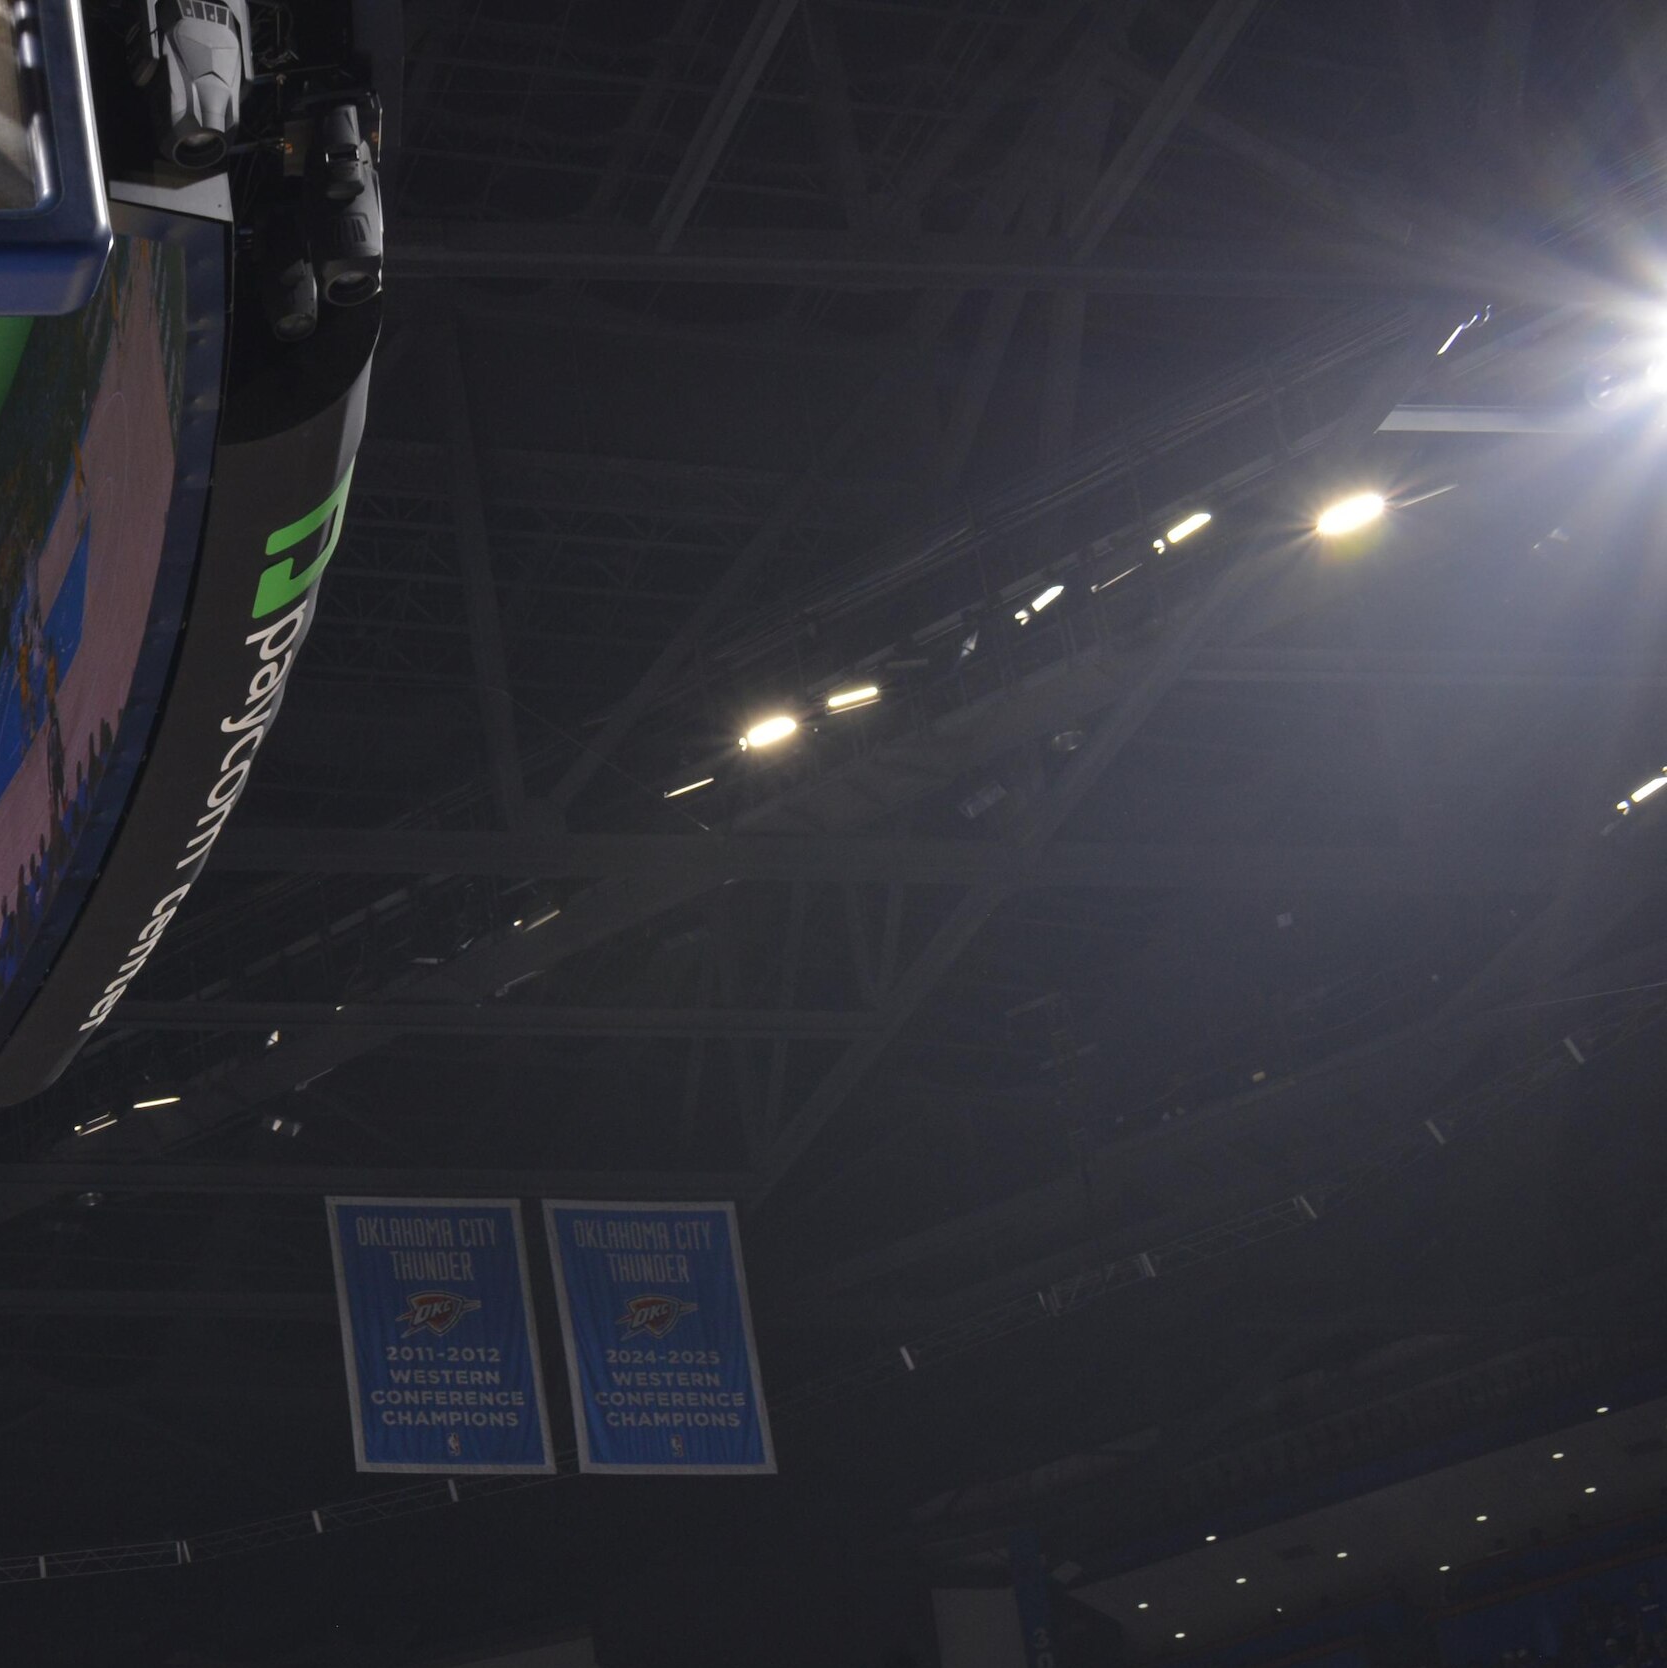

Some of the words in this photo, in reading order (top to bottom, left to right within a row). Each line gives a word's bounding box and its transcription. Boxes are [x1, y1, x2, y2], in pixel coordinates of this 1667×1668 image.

[175, 598, 310, 870] paycom
[78, 882, 191, 1032] center
[355, 1216, 454, 1248] OKLAHOMA
[459, 1216, 498, 1247] CITY
[572, 1219, 668, 1251] OKLAHOMA
[674, 1221, 712, 1252] CITY
[390, 1251, 475, 1281] THUNDER
[605, 1254, 690, 1284] THUNDER
[385, 1346, 501, 1364] 2011-2012
[605, 1349, 720, 1366] 2024-2025
[390, 1369, 501, 1386] WESTERN
[611, 1372, 721, 1388] WESTERN
[370, 1390, 525, 1407] CONFERENCE
[594, 1391, 746, 1409] CONFERENCE
[381, 1410, 519, 1427] CHAMPIONS
[605, 1411, 742, 1429] CHAMPIONS
